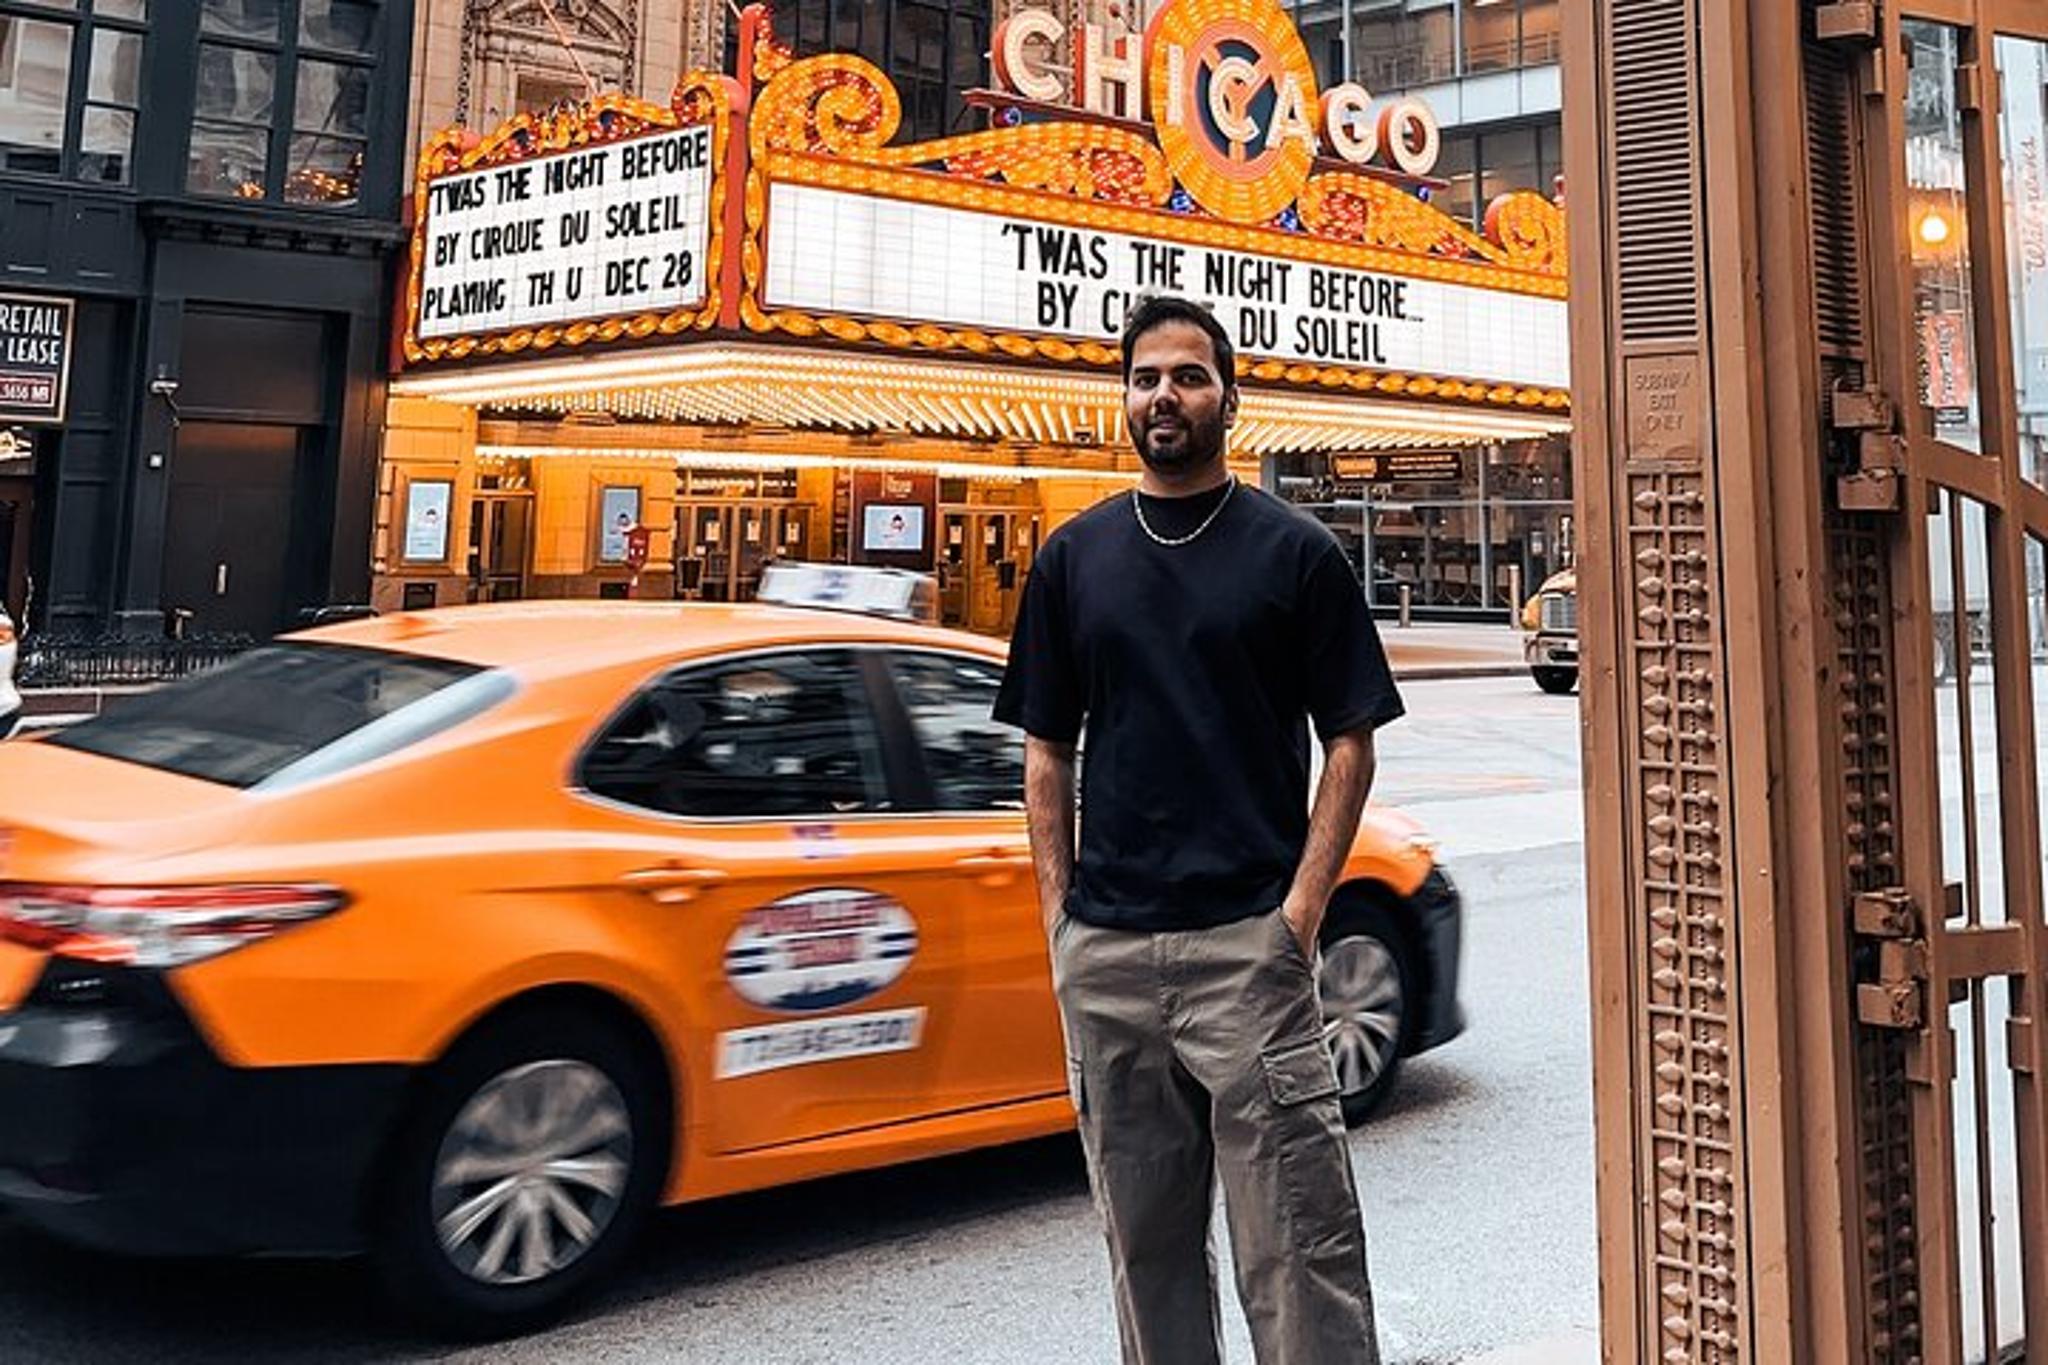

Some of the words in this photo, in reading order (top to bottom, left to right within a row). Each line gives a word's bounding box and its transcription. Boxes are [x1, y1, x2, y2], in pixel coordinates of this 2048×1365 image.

[1000, 9, 1440, 176] CHICAGO
[496, 166, 533, 205] THE
[545, 151, 609, 196] NIGHT
[622, 131, 708, 181] BEFORE
[435, 233, 461, 267] BY
[471, 219, 544, 260] CIRQUE
[560, 210, 590, 248] DU
[605, 195, 685, 239] SOLEIL
[1001, 224, 1108, 280] 'TWAS
[1130, 241, 1185, 291] THE
[1205, 254, 1292, 305] NIGHT
[0, 303, 61, 336] RETAIL
[423, 278, 505, 320] PLAYING
[605, 256, 651, 297] DEC
[662, 250, 692, 290] 28
[1036, 281, 1078, 332] BY
[8, 337, 60, 365] LEASE
[1240, 306, 1277, 351] DU
[1294, 316, 1387, 364] SOLEIL
